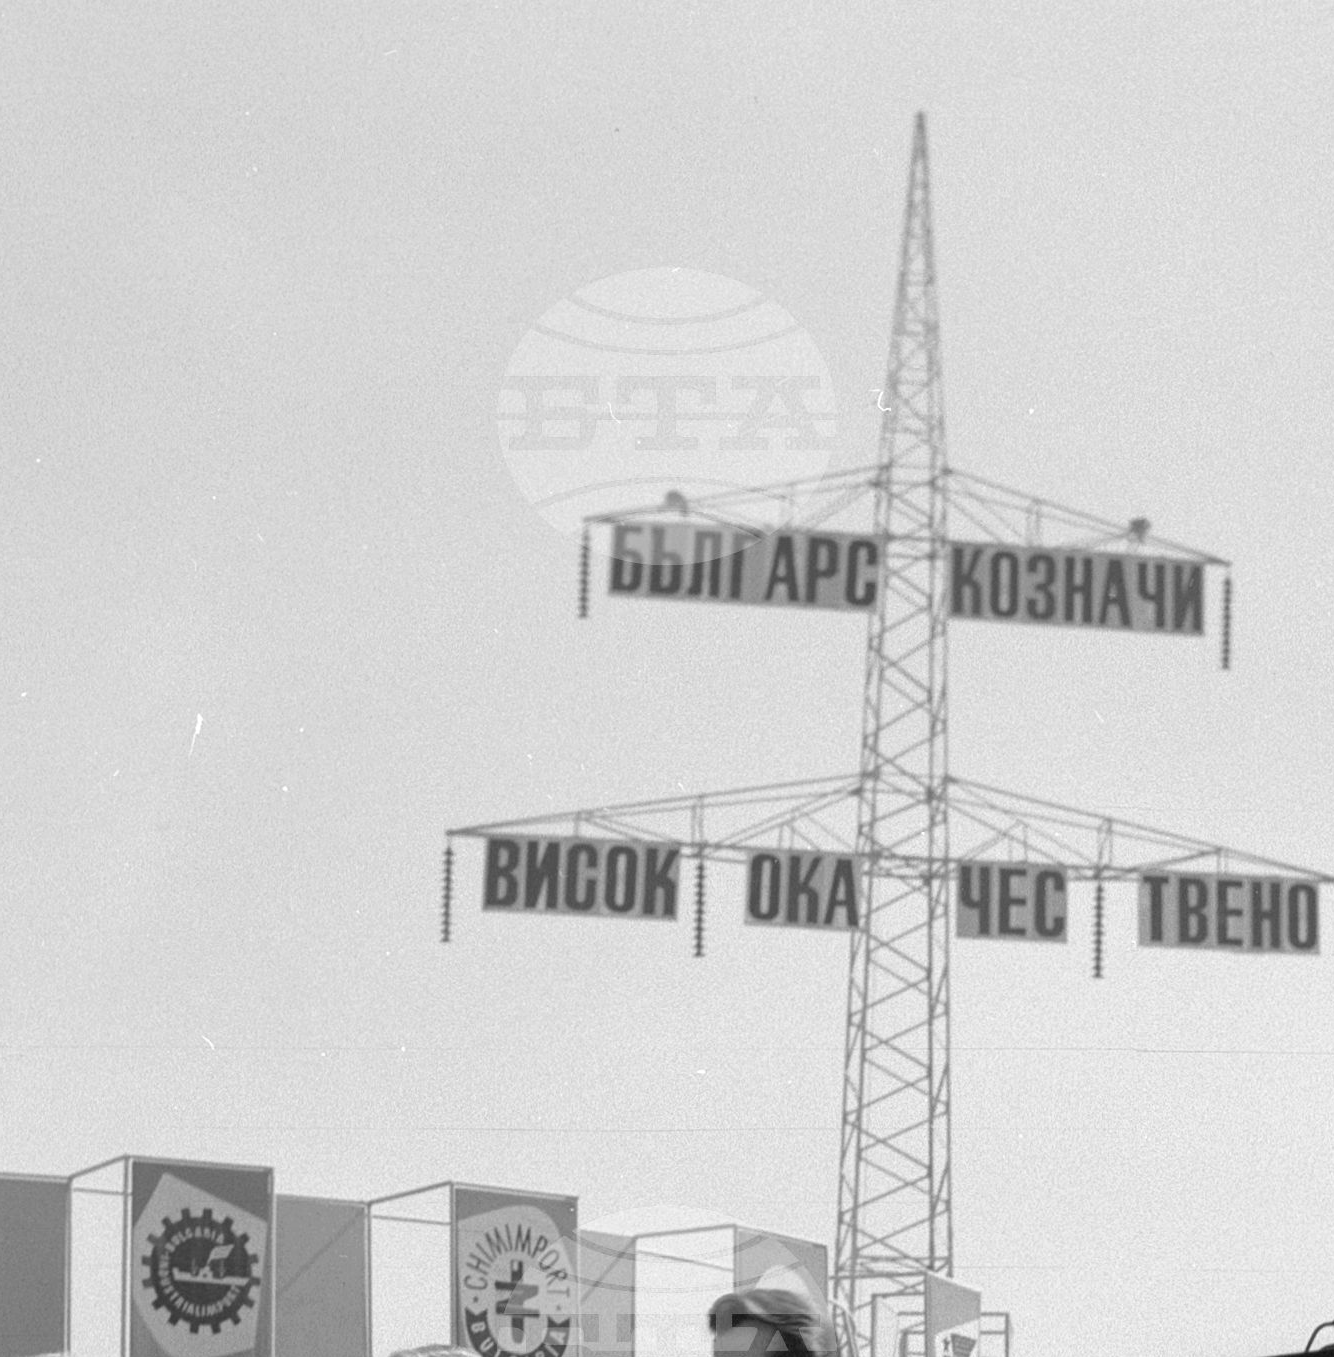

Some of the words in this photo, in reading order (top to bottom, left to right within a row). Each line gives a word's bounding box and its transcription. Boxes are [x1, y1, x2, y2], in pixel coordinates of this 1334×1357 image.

[951, 548, 1204, 633] КОЗНАЧИ
[483, 838, 680, 916] ВИСОК
[748, 853, 860, 927] ОКА
[959, 865, 1065, 937] ЧЕС
[1143, 875, 1319, 950] ТВЕНО
[464, 1223, 571, 1299] CHIMIMPORT
